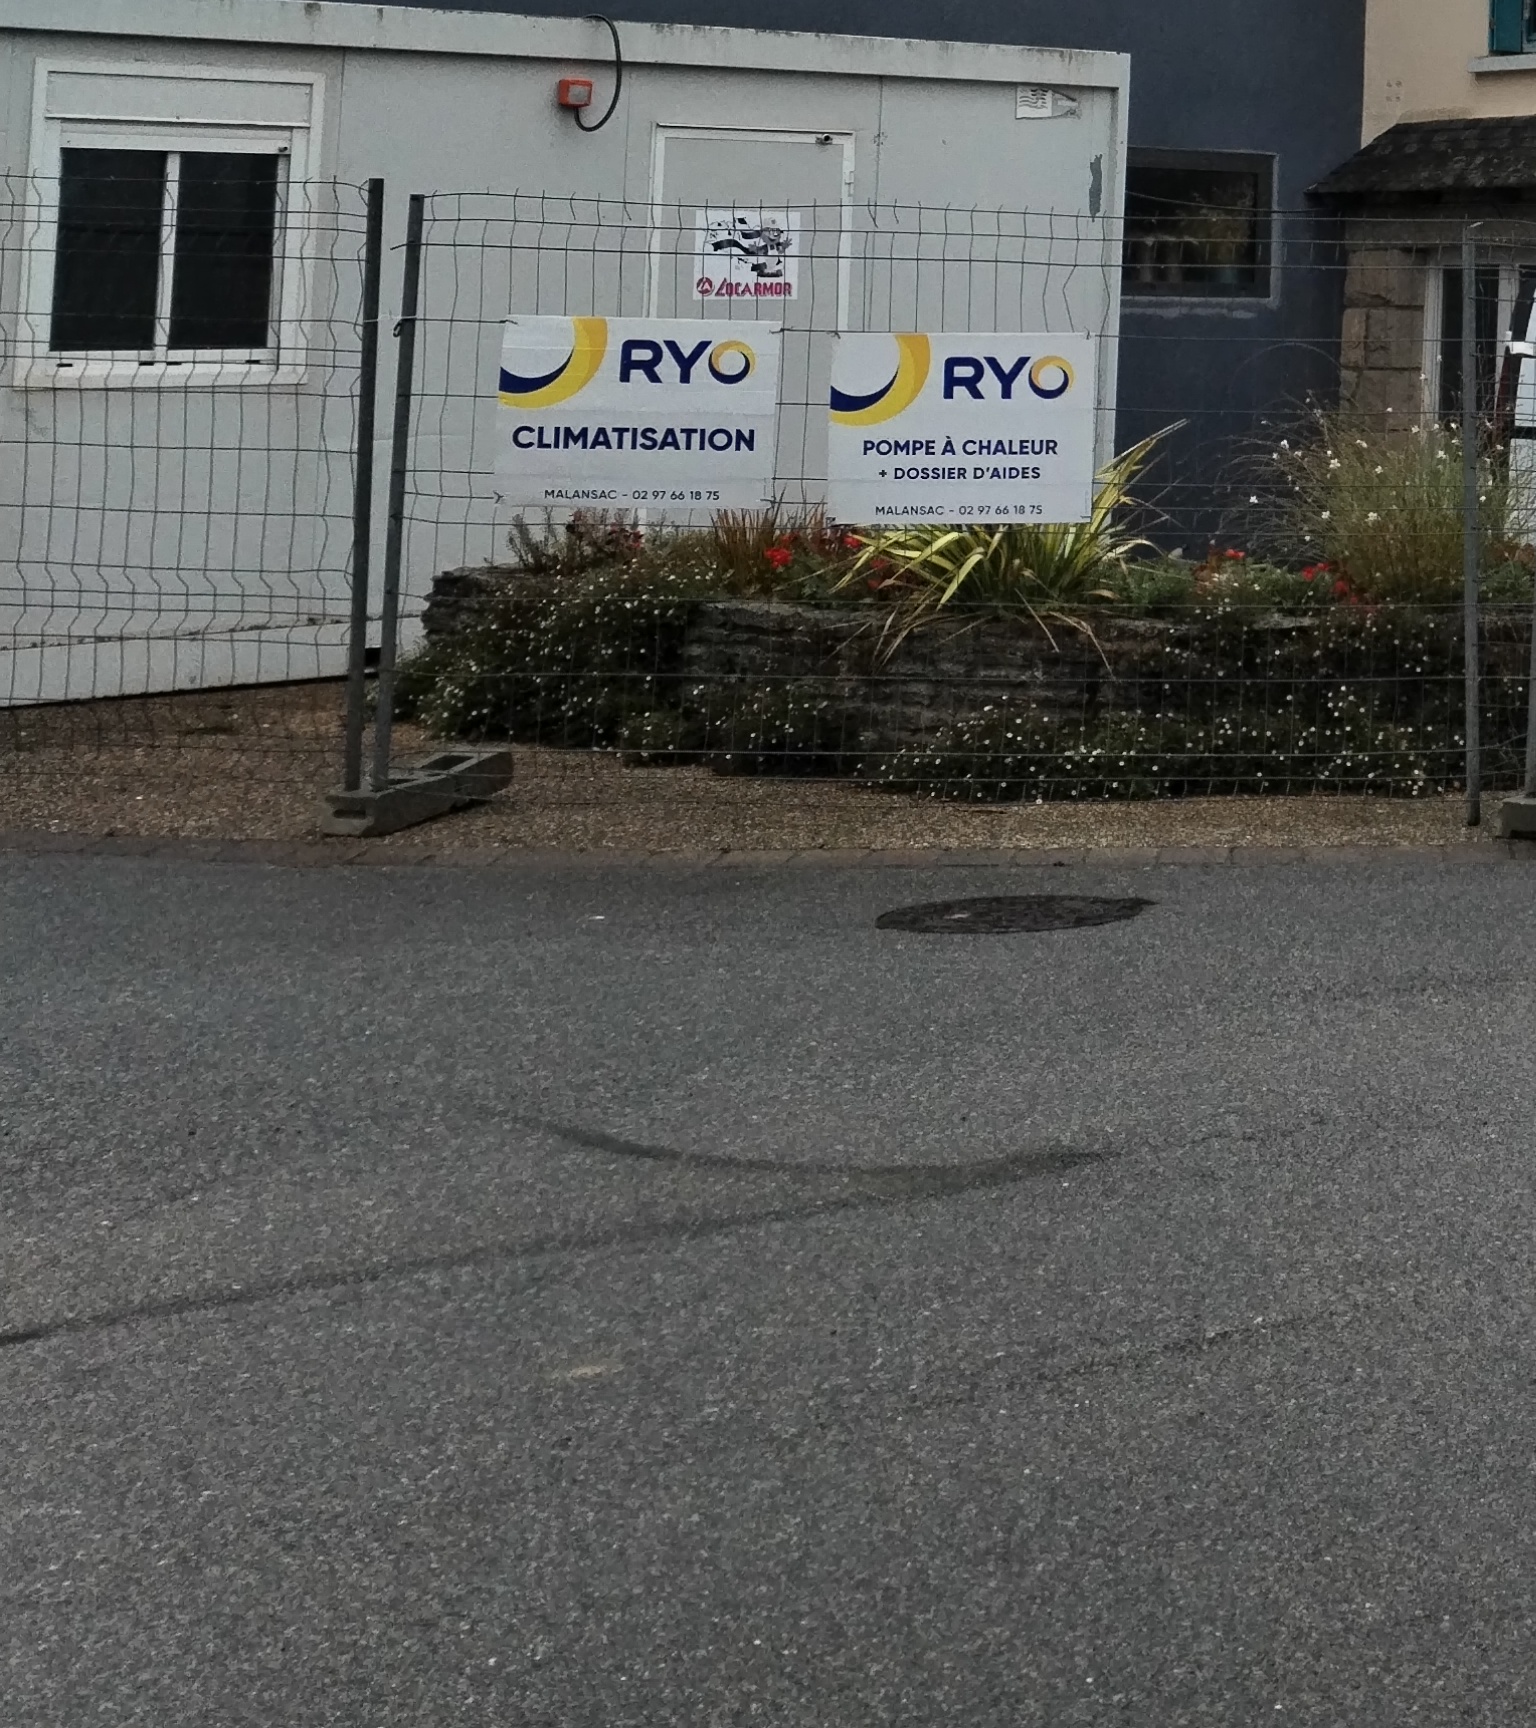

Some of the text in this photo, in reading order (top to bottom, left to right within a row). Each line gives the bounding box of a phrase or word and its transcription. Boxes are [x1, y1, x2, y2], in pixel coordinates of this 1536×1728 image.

[715, 278, 793, 297] LOCARMOR
[619, 339, 756, 385] RYO
[943, 355, 1075, 400] RYO
[512, 425, 755, 452] CLIMATISATION
[863, 435, 1058, 456] POMPE À CHALEUR
[894, 467, 967, 480] DOSSIER
[972, 466, 1041, 480] D'AIDES
[544, 489, 617, 500] MALANSAC
[632, 490, 648, 500] 02
[652, 490, 666, 500] 97
[670, 490, 685, 501] 66
[690, 490, 702, 501] 18
[706, 490, 720, 501] 75
[875, 505, 945, 516] MALANSAC
[958, 505, 974, 515] 02
[977, 505, 991, 515] 97
[995, 505, 1009, 515] 66
[1013, 505, 1025, 515] 18
[1029, 504, 1043, 515] 75
